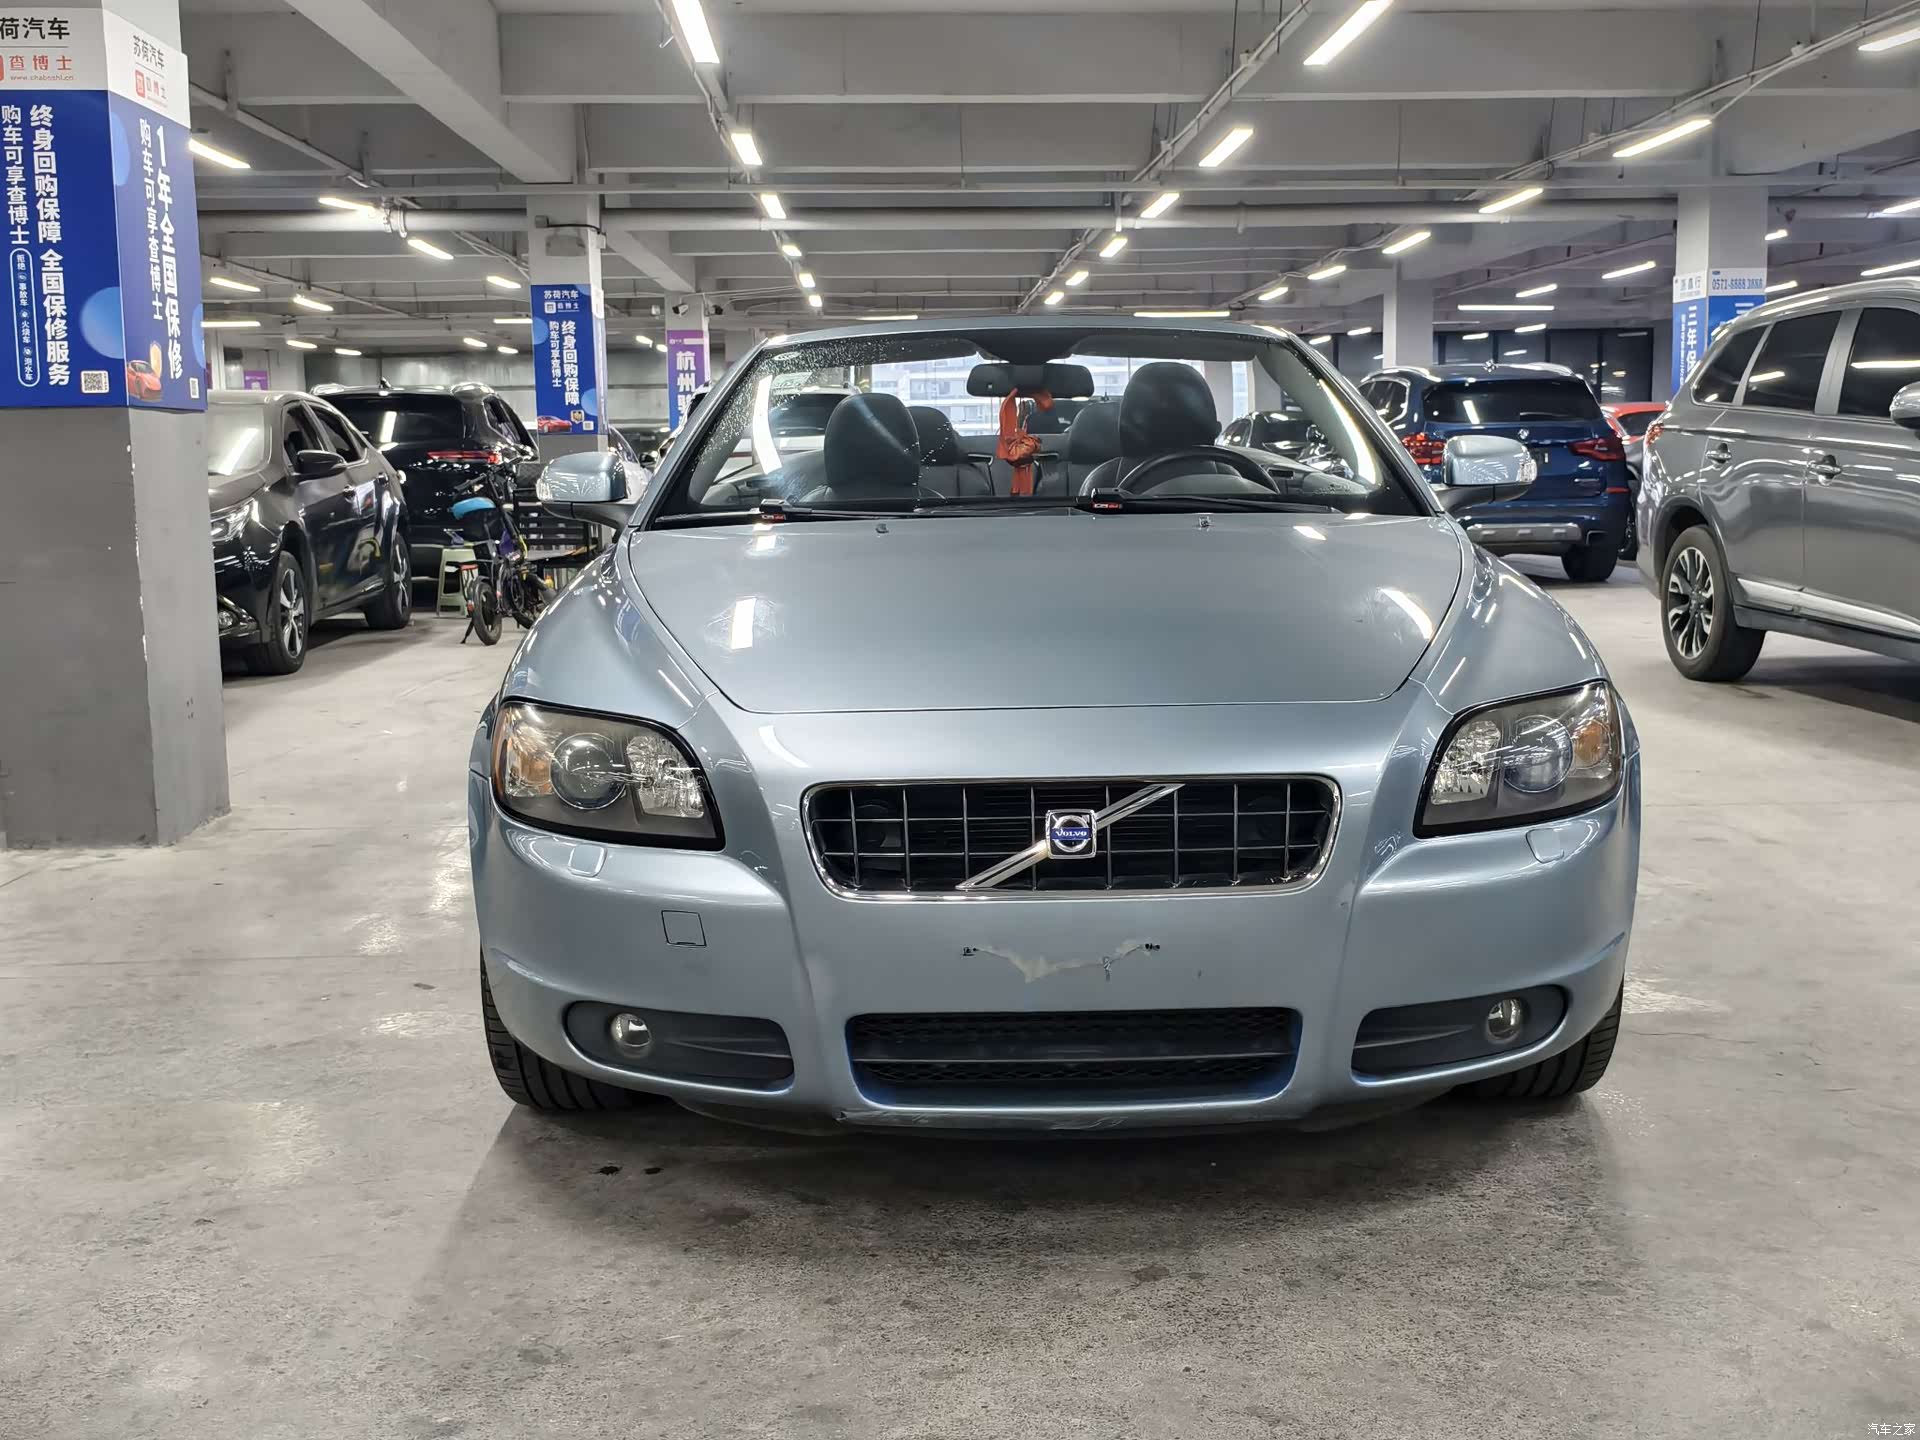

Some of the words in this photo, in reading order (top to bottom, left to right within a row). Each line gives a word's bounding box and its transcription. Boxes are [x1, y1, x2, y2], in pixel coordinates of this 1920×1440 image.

[0, 17, 70, 40] 荷汽车
[9, 55, 72, 71] 查博士
[1, 105, 30, 245] 购车可享查博士
[30, 104, 61, 243] 终身回购保障
[40, 249, 71, 386] 全国保修服务
[562, 320, 580, 406] 终身回购保障
[1055, 829, 1087, 837] VOLVO
